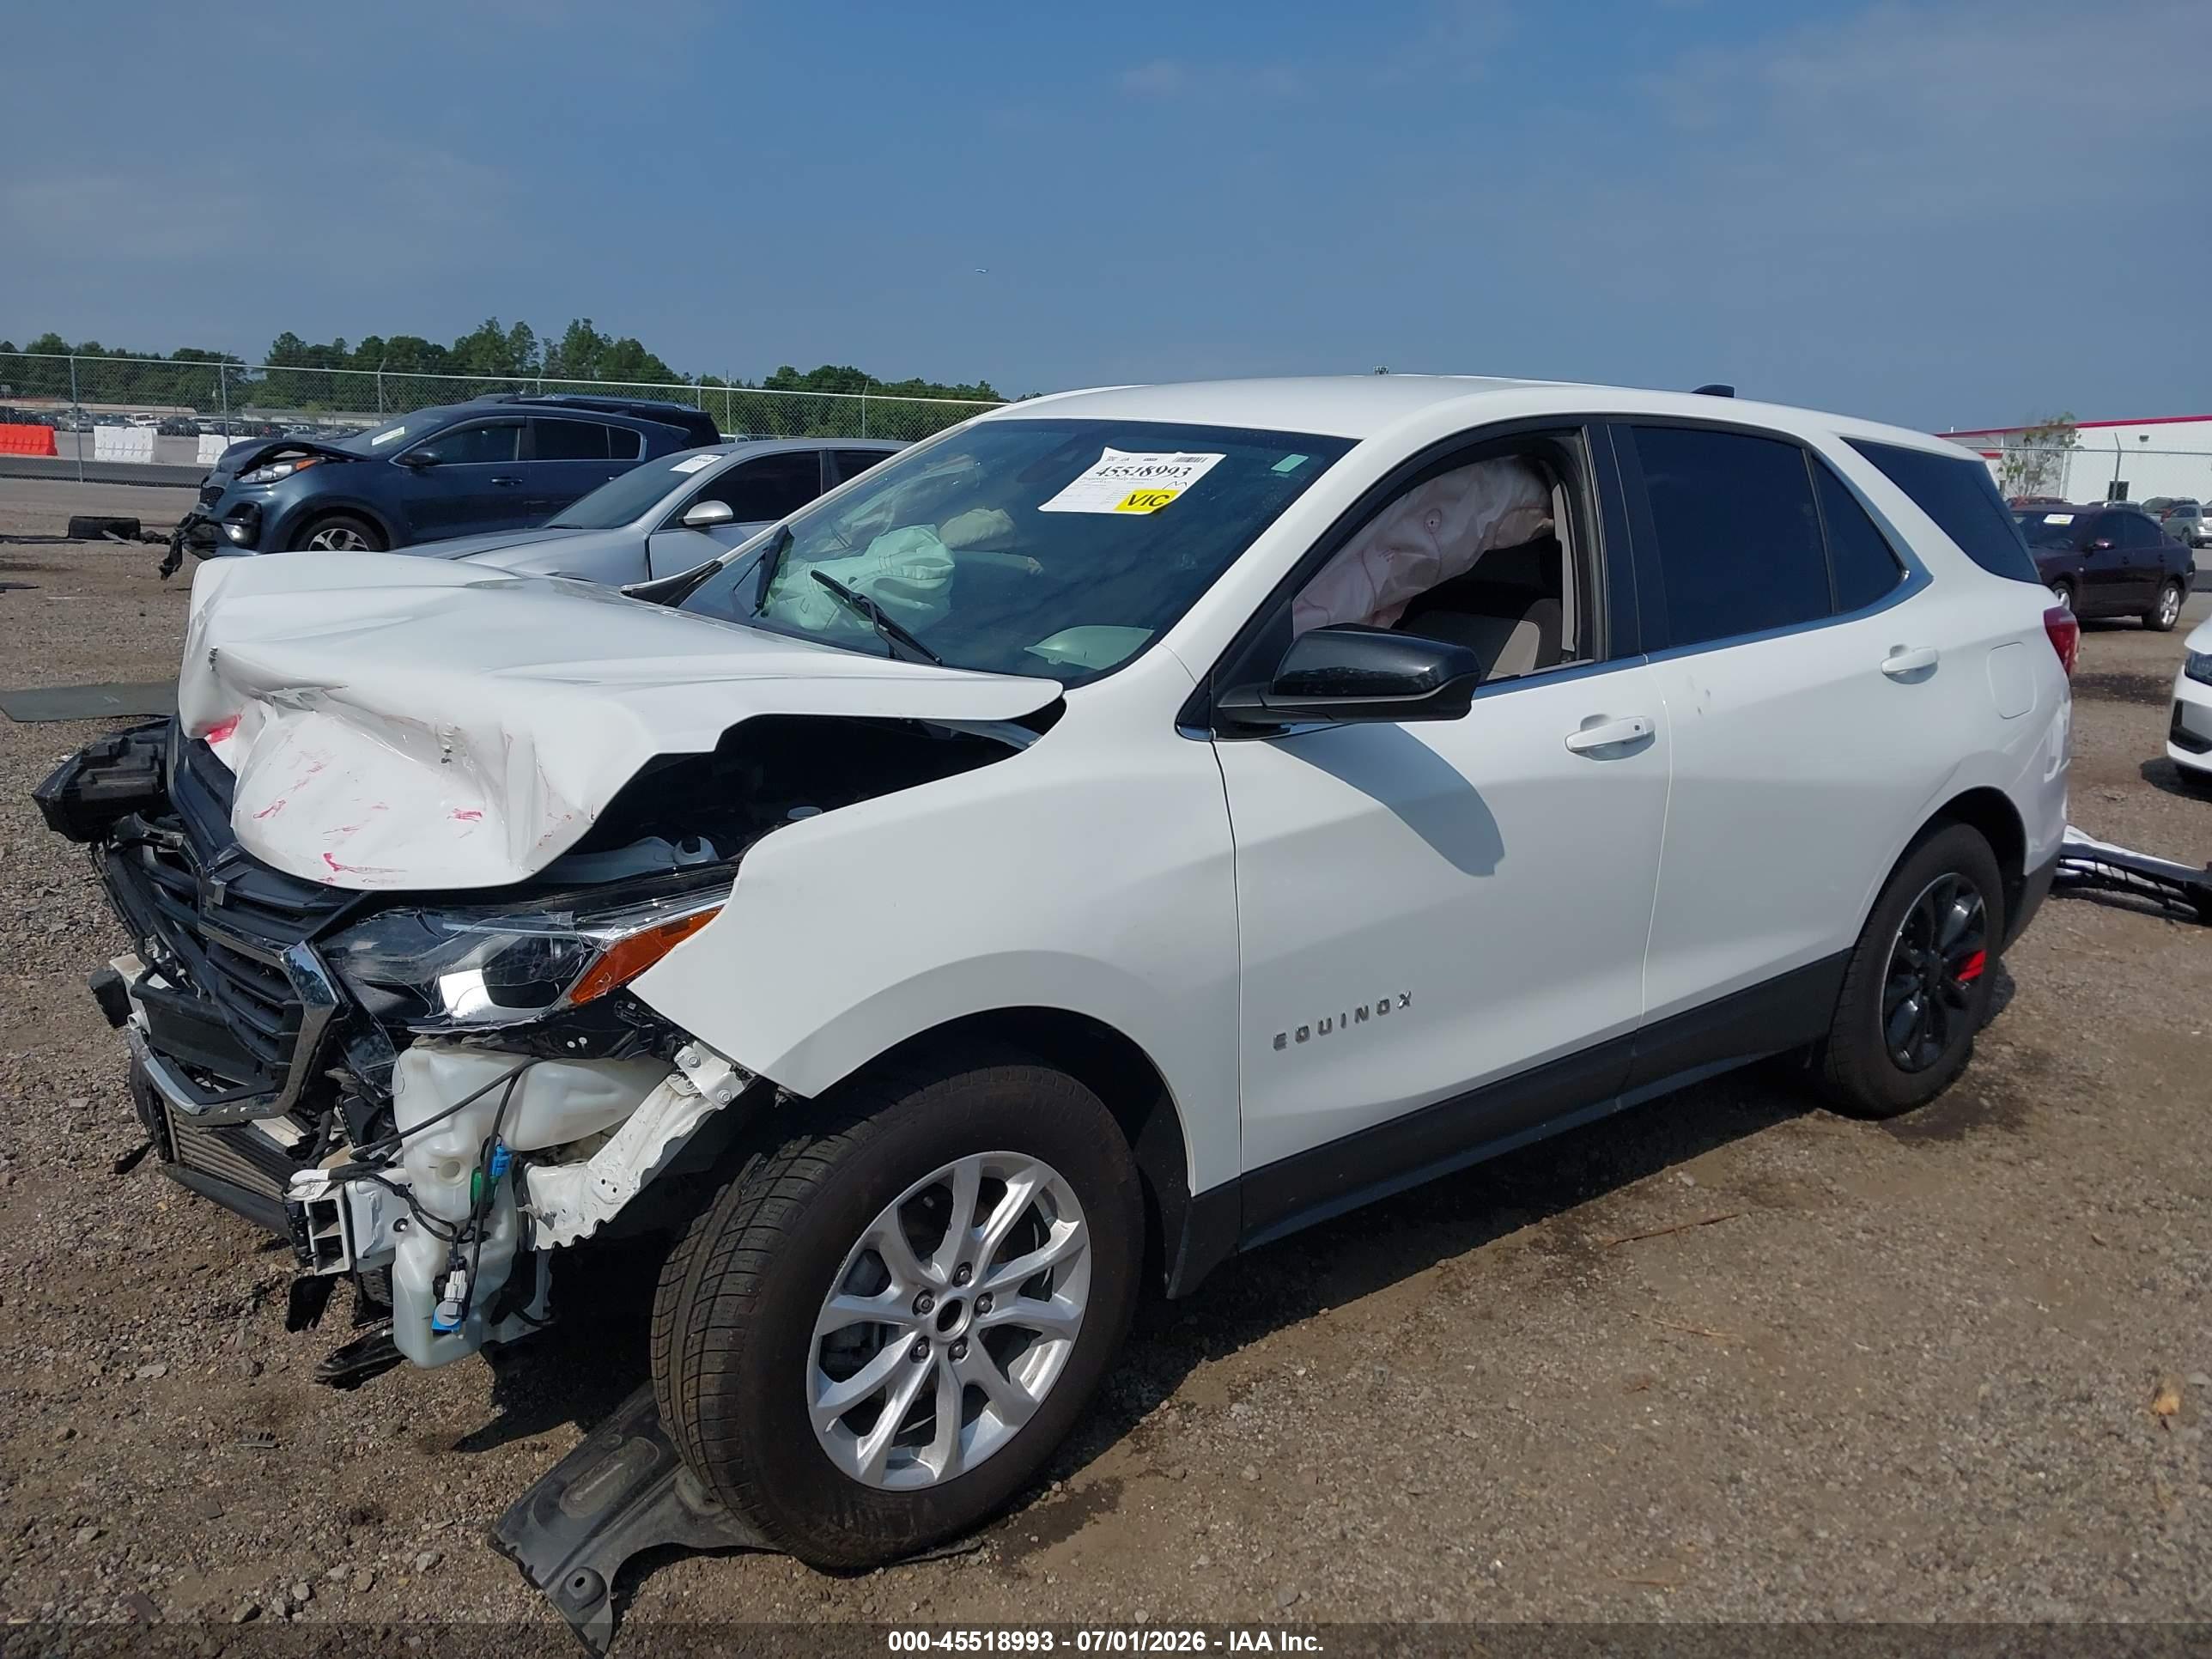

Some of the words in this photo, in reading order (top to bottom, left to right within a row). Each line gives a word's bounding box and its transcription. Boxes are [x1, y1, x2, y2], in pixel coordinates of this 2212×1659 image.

[1096, 465, 1193, 478] 45518993
[1127, 494, 1170, 507] VIC
[1273, 990, 1413, 1052] EQUINOX
